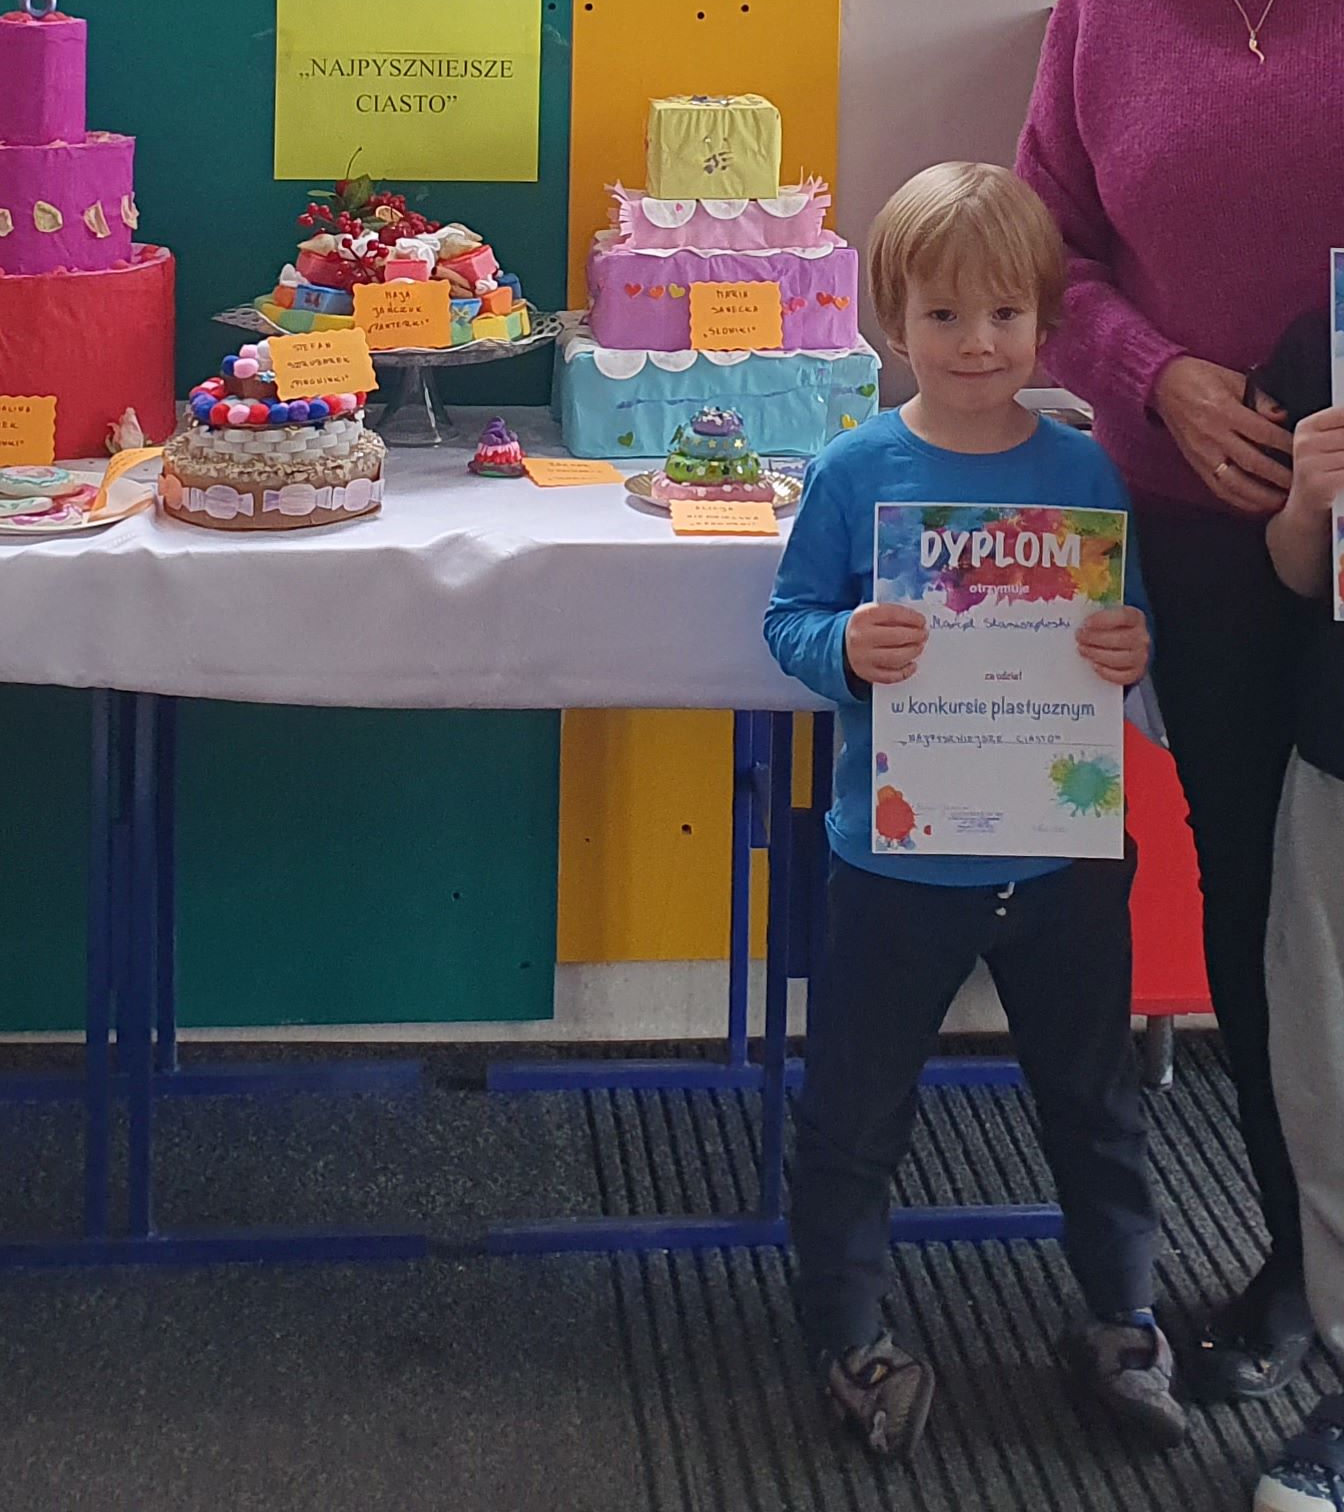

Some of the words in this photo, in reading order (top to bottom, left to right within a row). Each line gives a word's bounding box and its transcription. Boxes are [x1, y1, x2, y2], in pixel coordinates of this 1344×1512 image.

[299, 58, 514, 79] „NAJPYSZNIEJSZE
[356, 94, 458, 114] CIASTO”
[920, 530, 1081, 569] DYPLOM
[891, 703, 904, 714] w
[908, 695, 987, 716] konkursie
[991, 697, 1095, 720] plastycznym
